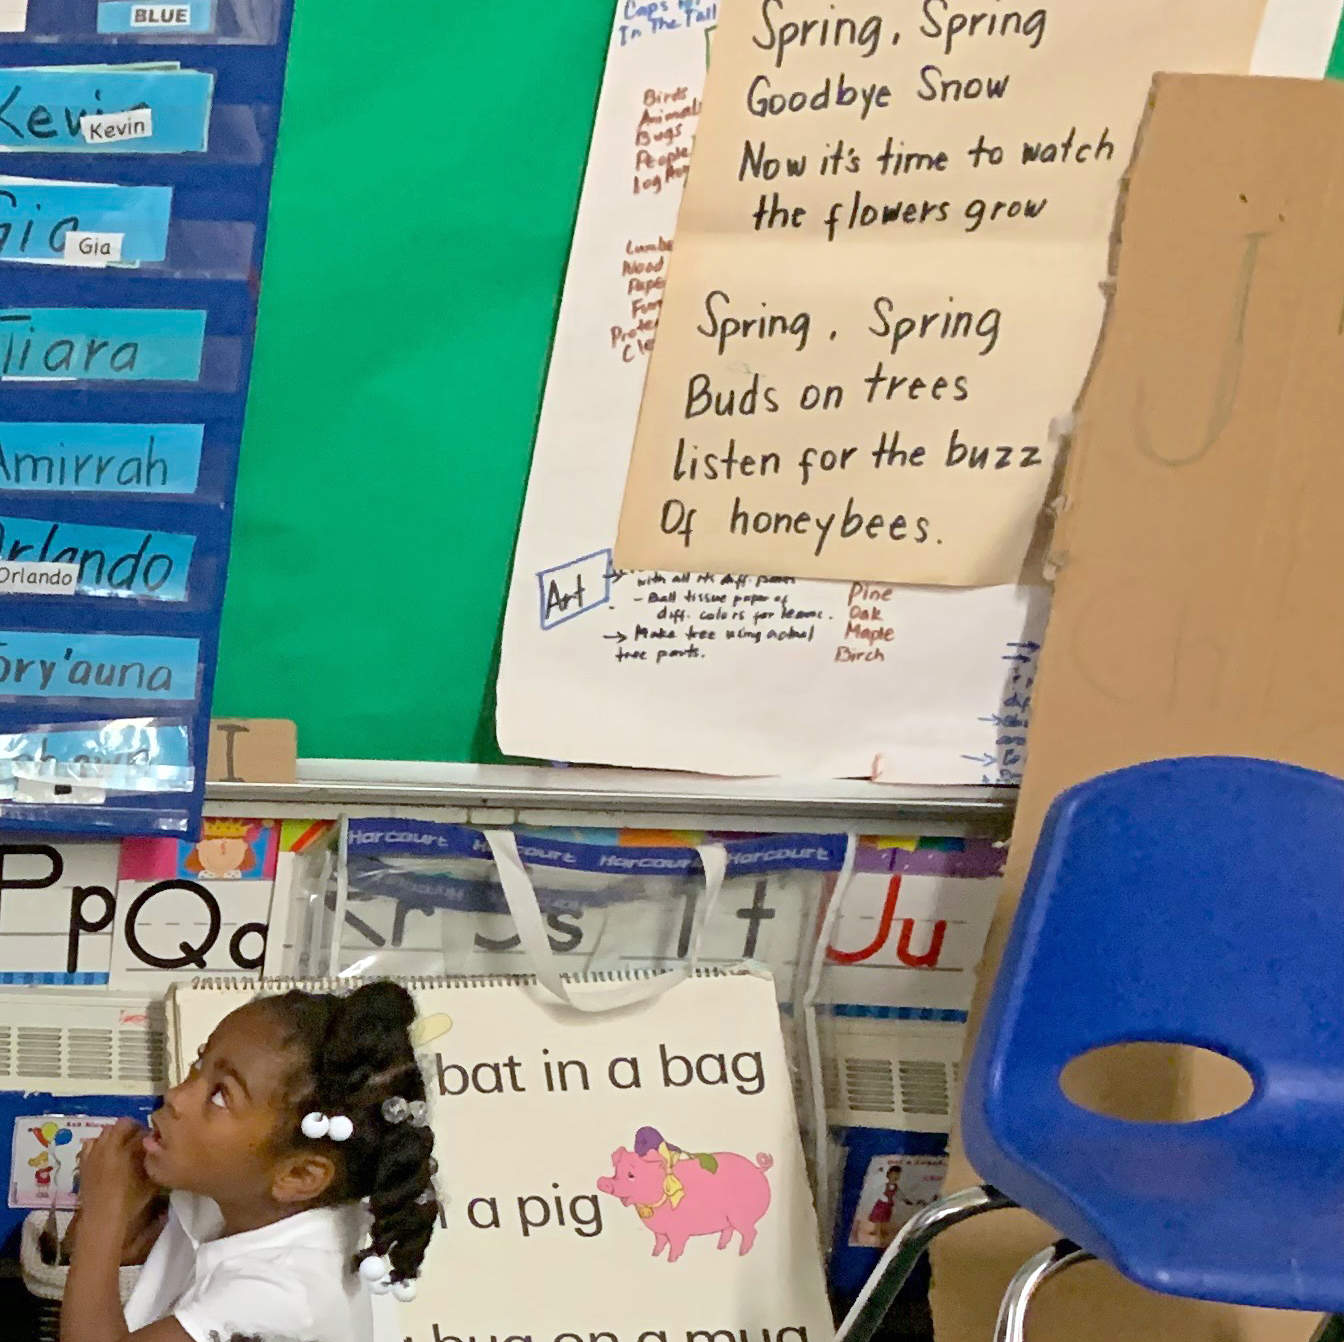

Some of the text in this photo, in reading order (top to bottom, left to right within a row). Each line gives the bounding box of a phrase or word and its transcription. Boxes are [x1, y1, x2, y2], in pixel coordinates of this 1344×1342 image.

[134, 8, 187, 24] BLUE
[921, 0, 1048, 49] Spring
[748, 65, 1010, 120] Goodbye Snow
[89, 116, 146, 141] Kevin
[739, 127, 1115, 182] Now it's time to watch
[753, 191, 1048, 241] the flowers grow
[79, 237, 111, 257] Gia
[868, 295, 1001, 354] Spring
[686, 362, 969, 419] Buds on trees
[798, 445, 857, 485] for
[872, 432, 924, 469] the
[945, 428, 1042, 469] buzz
[730, 497, 943, 557] honeybees.
[545, 574, 585, 618] Art
[848, 582, 893, 606] Pine
[834, 645, 885, 663] Birch
[844, 620, 896, 645] Maple
[348, 830, 448, 849] Harcourt
[435, 1043, 766, 1096] bat in a bag
[466, 1182, 604, 1237] a pig
